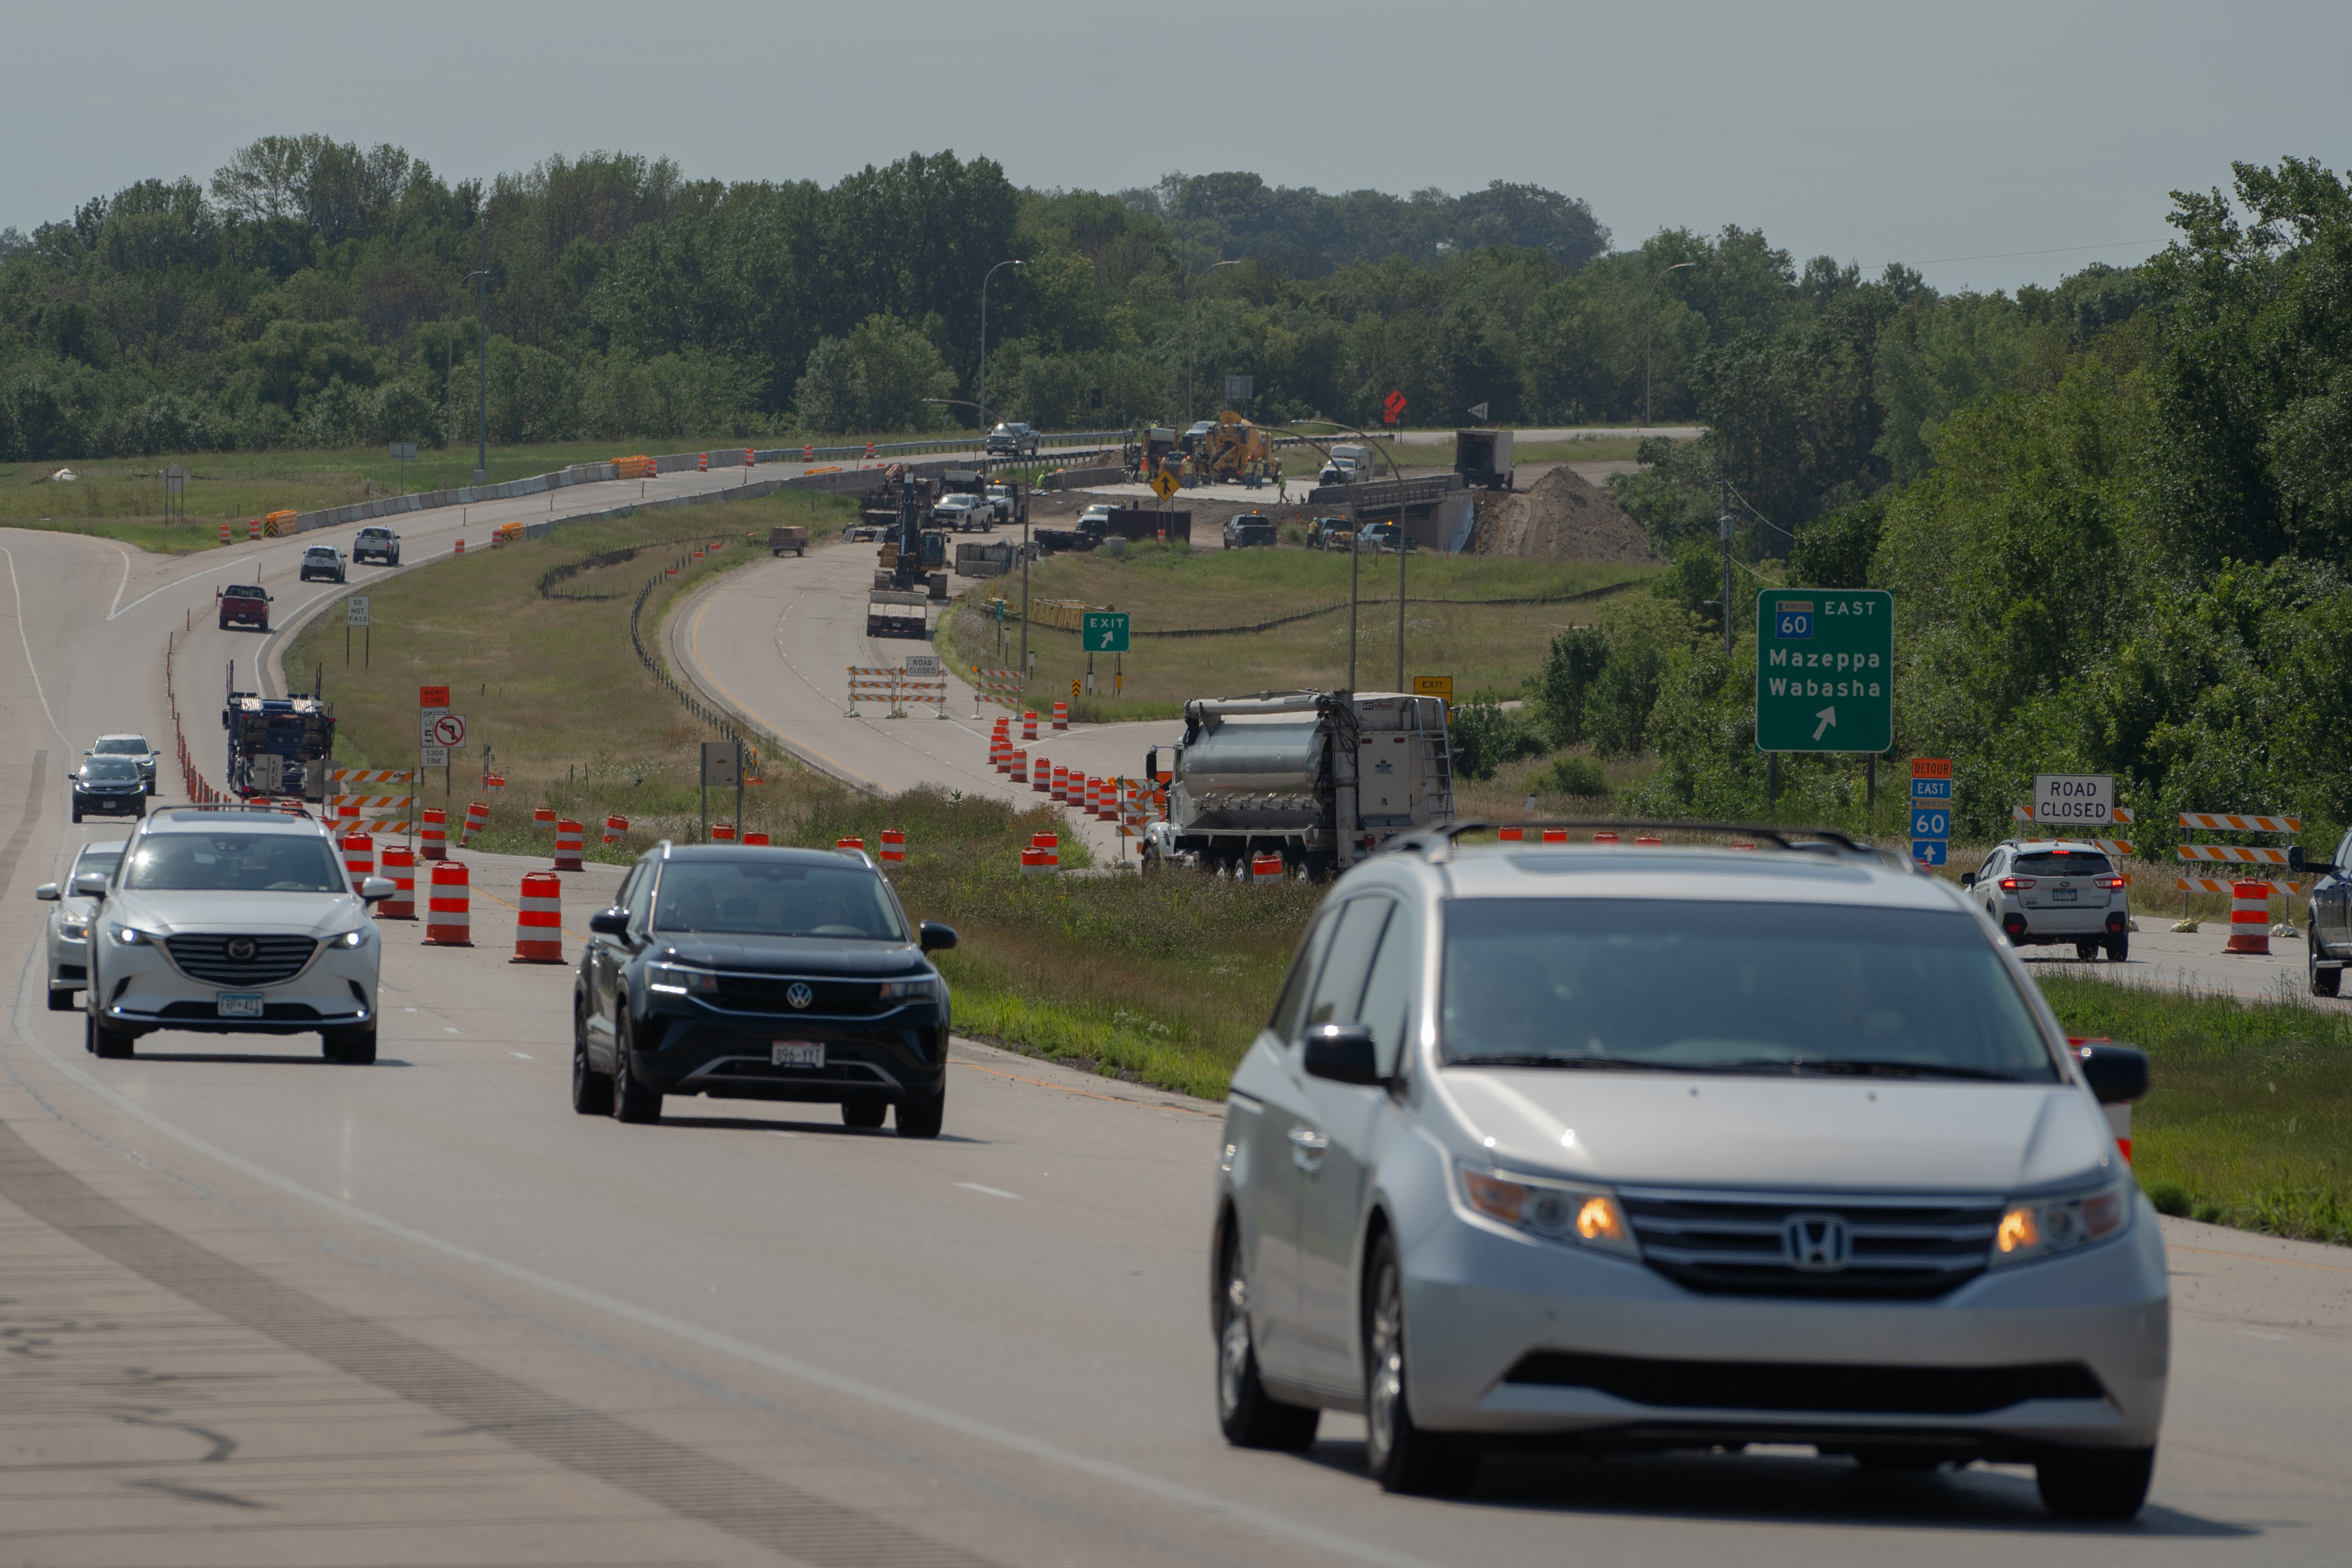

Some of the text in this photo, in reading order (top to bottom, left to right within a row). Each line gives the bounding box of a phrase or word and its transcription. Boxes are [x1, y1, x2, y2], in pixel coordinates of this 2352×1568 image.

[1825, 601, 1875, 615] EAST
[1090, 618, 1124, 628] EXIT
[1781, 616, 1807, 633] 60
[1769, 648, 1880, 672] Mazeppa
[1769, 678, 1880, 697] Wabasha
[1915, 762, 1949, 775] DETOUR
[1917, 783, 1945, 795] EAST
[2050, 781, 2097, 797] ROAD
[2041, 802, 2106, 818] CLOSED
[1916, 814, 1945, 833] 60
